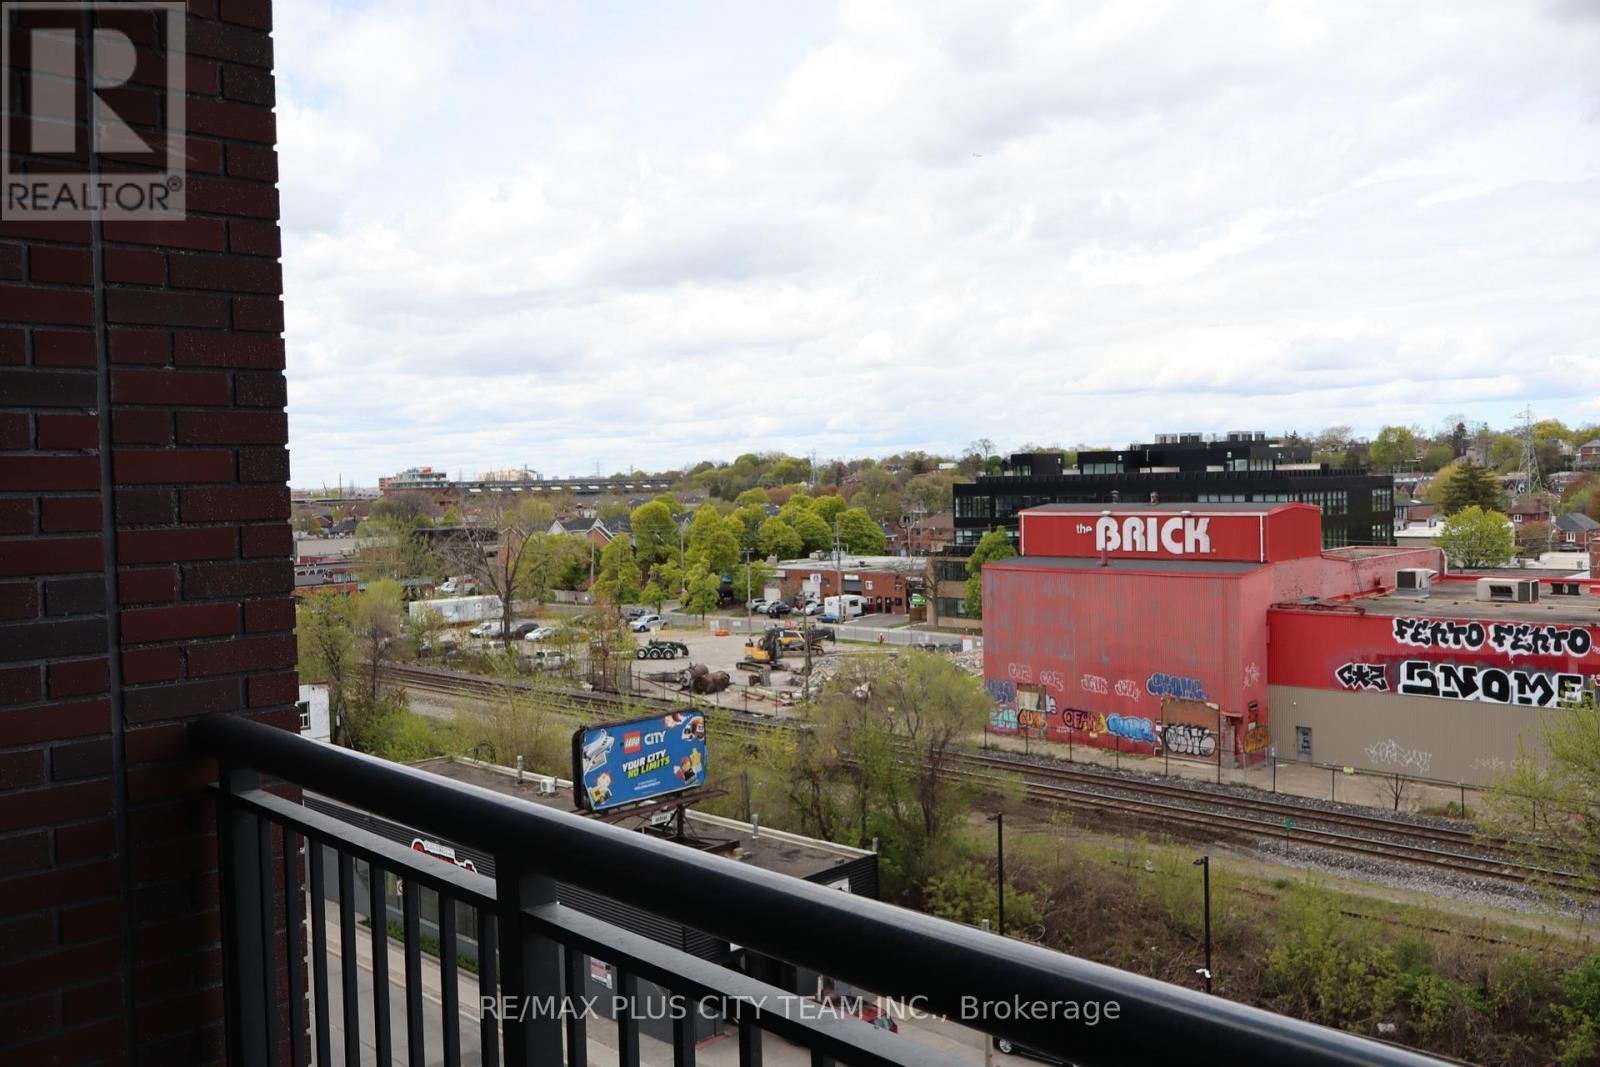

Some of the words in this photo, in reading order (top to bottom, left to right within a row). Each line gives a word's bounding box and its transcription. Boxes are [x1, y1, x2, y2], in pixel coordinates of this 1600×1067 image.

[1075, 523, 1093, 534] the
[1096, 516, 1211, 555] BRICK
[625, 737, 640, 748] LEGO
[645, 731, 666, 745] CITY
[623, 757, 646, 772] YOUR
[648, 749, 666, 763] CITY
[628, 768, 640, 778] NO
[641, 756, 670, 774] LIMITS
